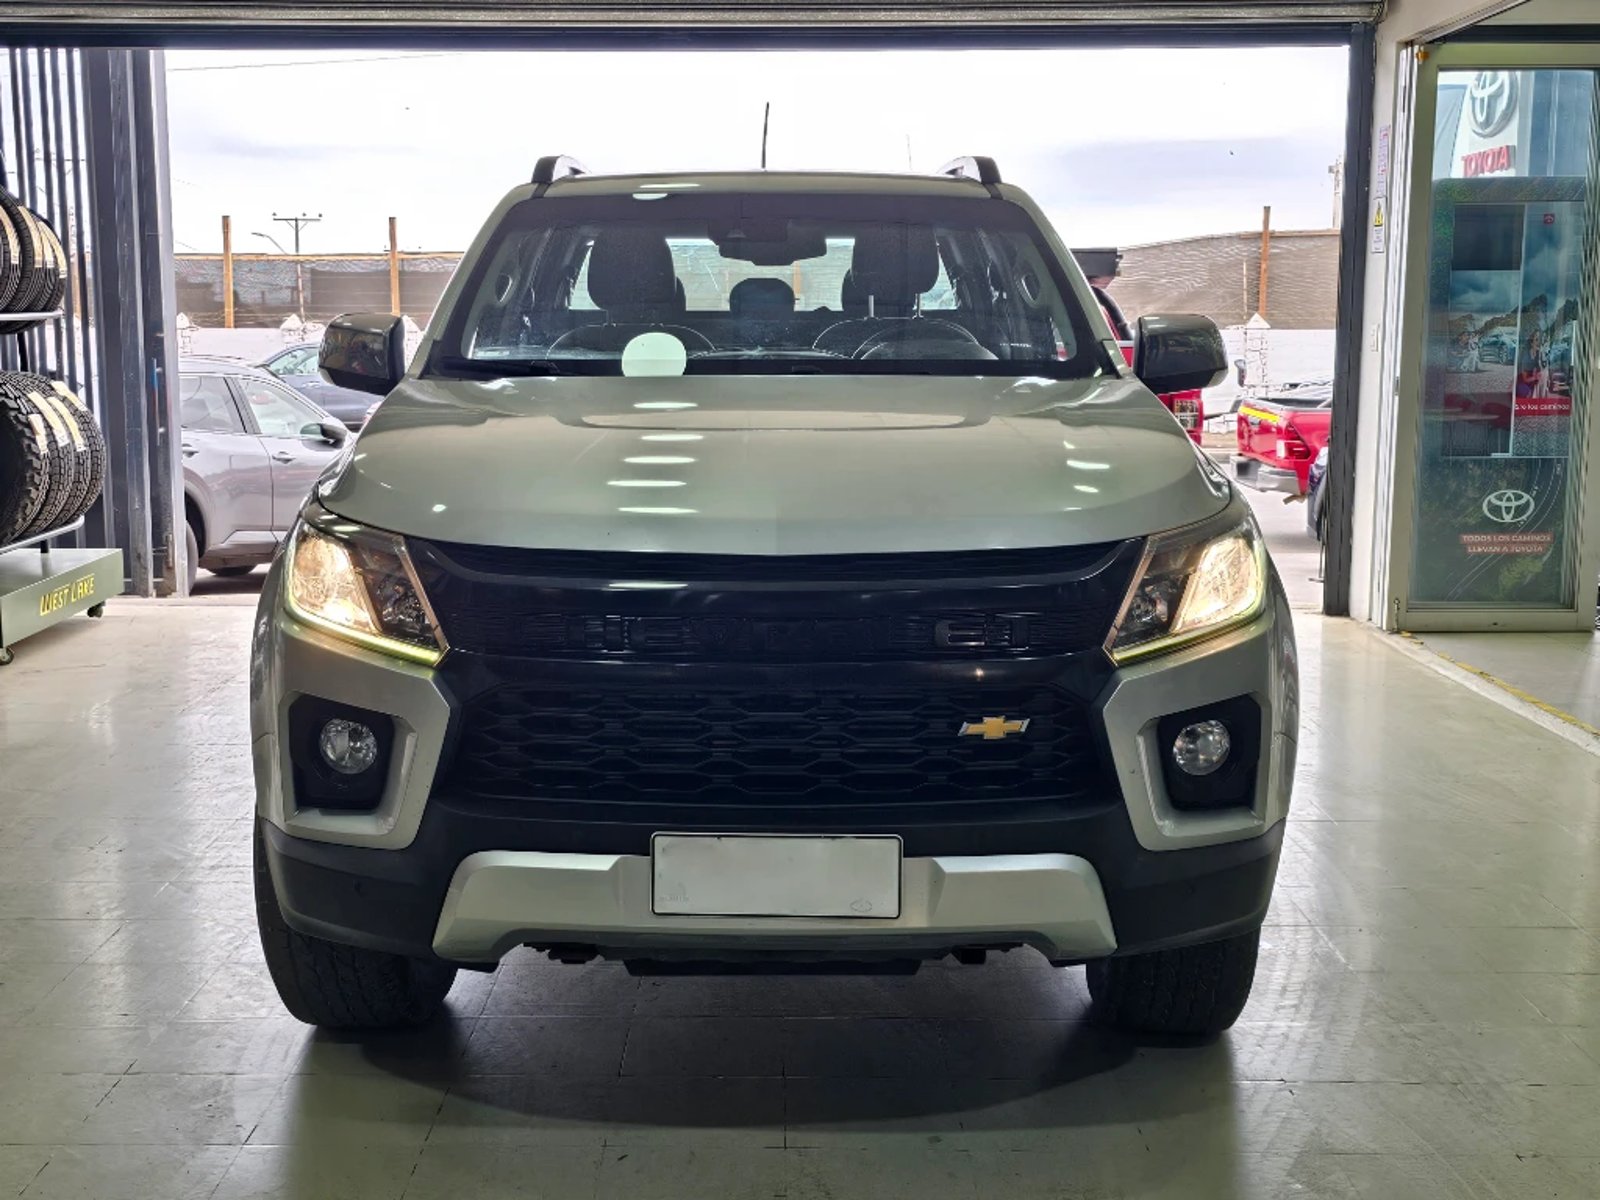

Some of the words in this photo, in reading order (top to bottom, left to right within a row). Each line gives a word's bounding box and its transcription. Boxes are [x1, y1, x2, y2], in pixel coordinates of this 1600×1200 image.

[1461, 145, 1512, 177] TOYOTA
[40, 586, 70, 616] WEST
[71, 575, 95, 603] LAKE
